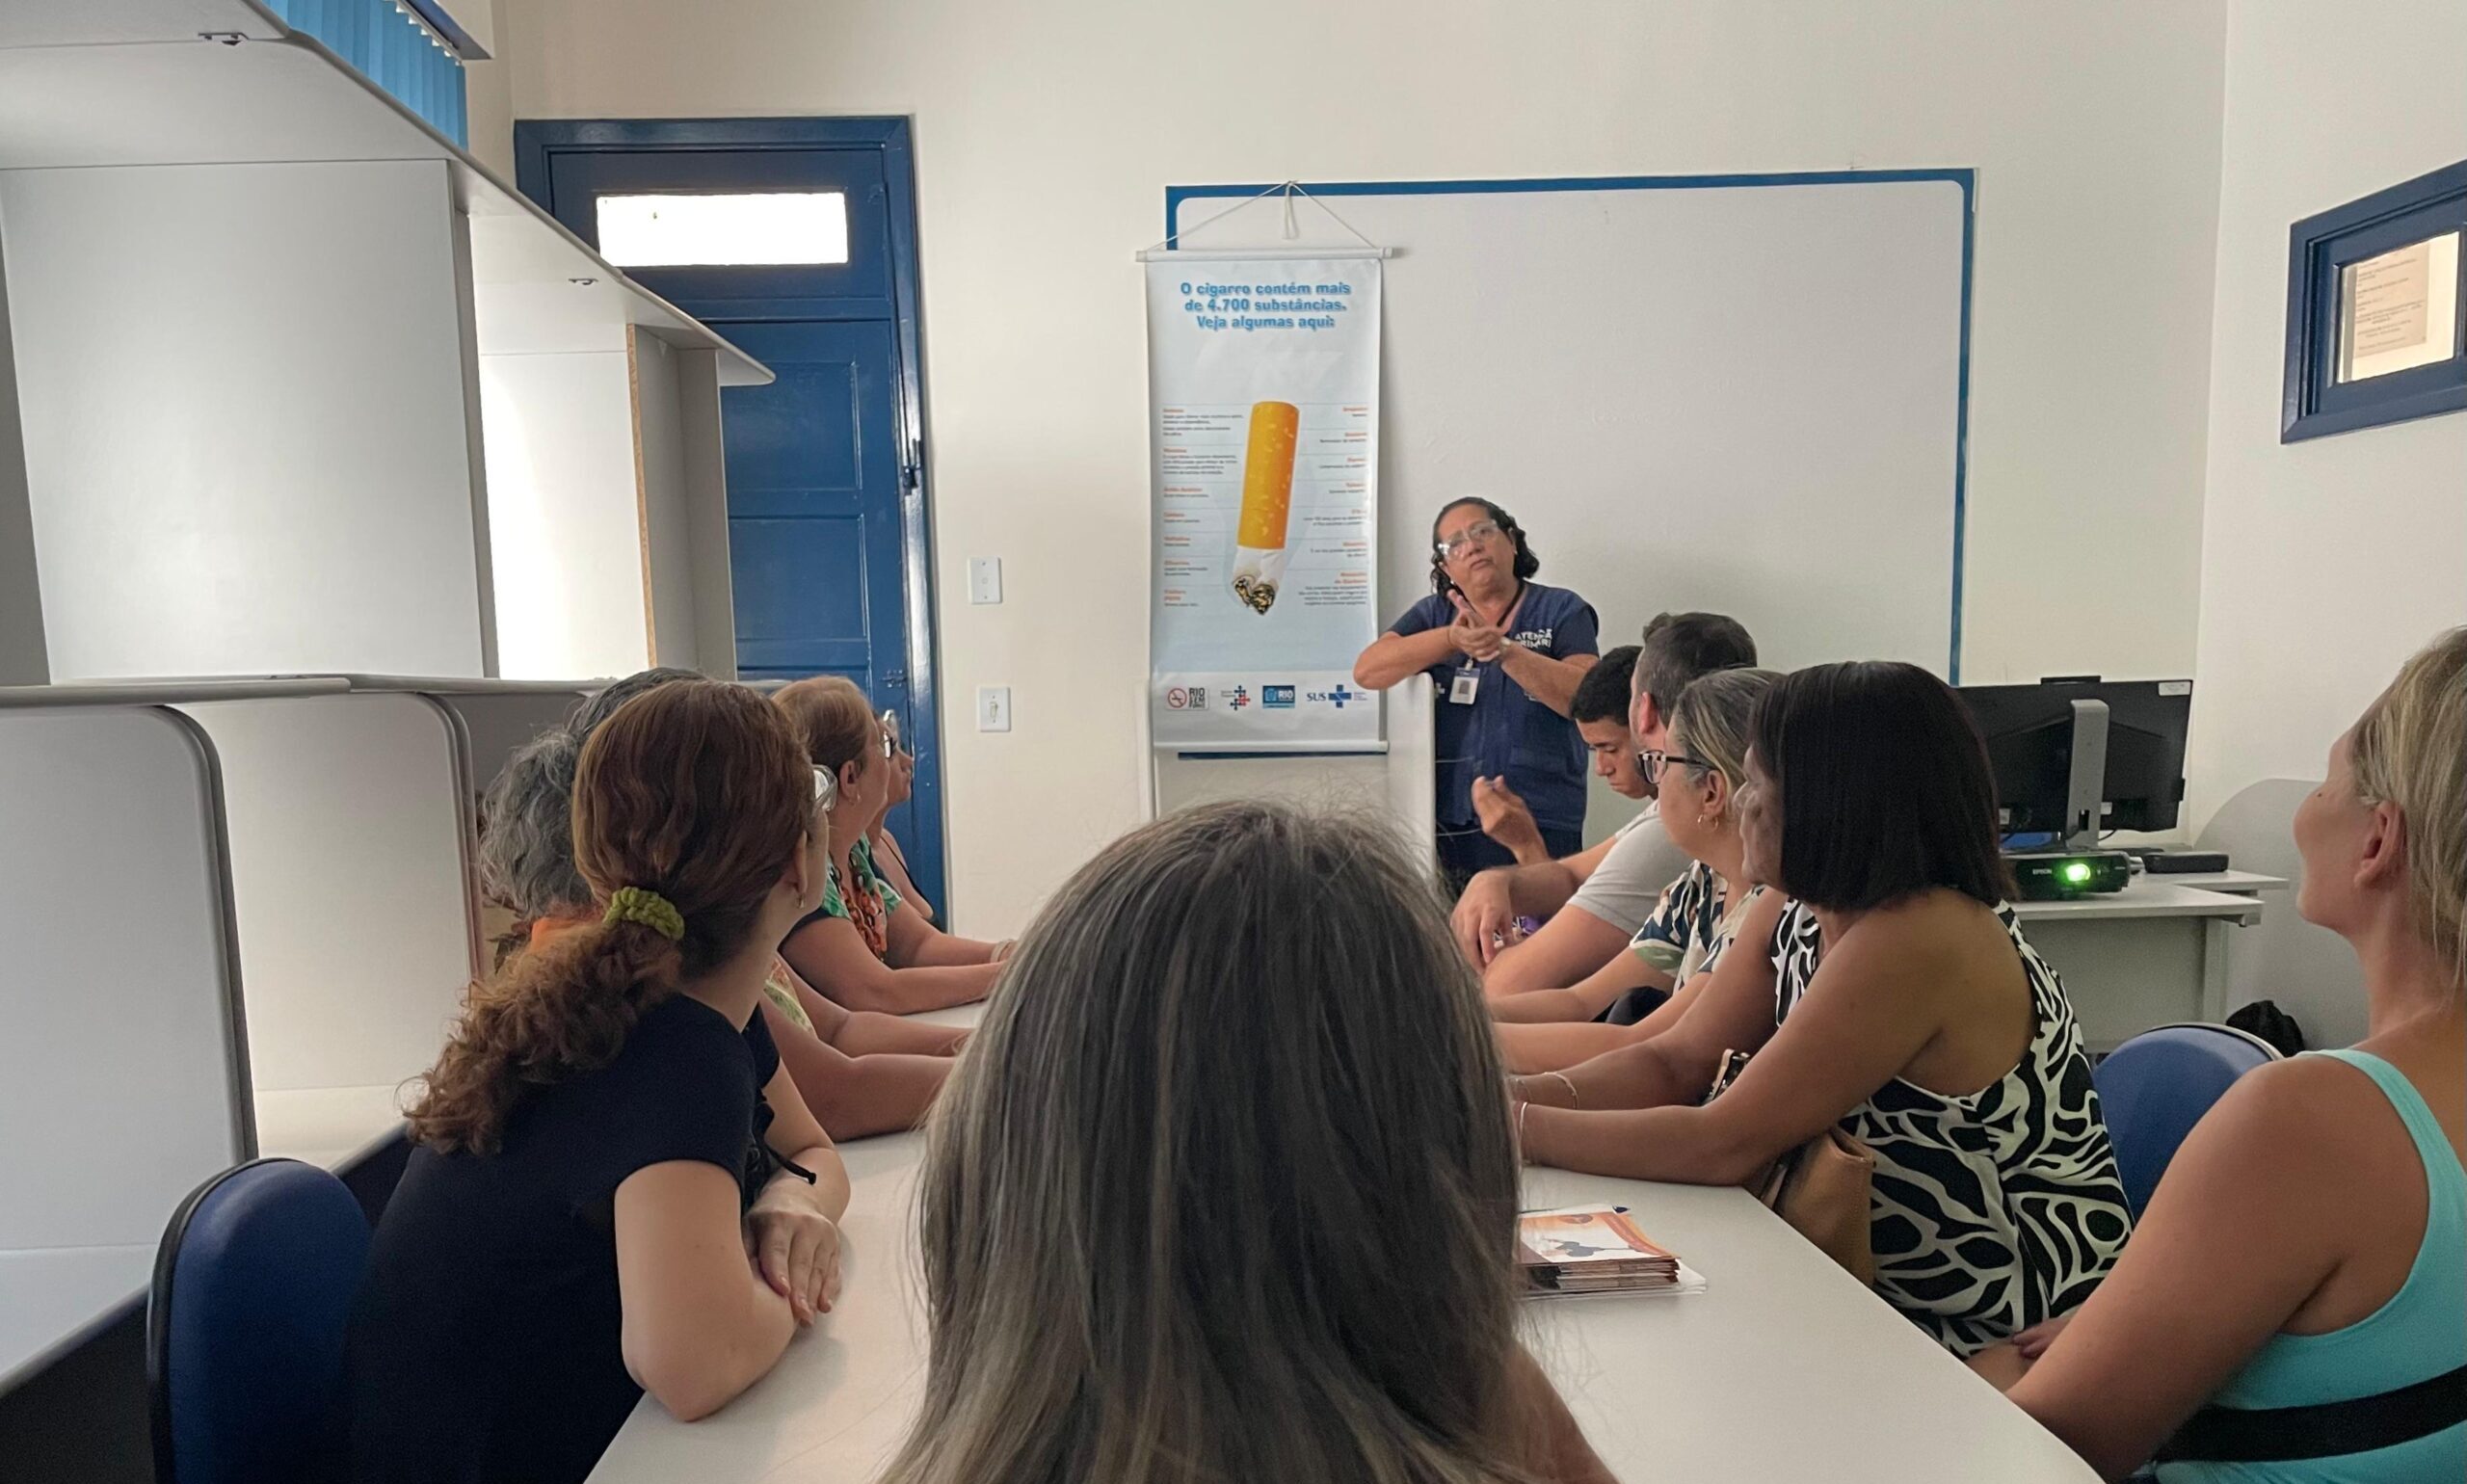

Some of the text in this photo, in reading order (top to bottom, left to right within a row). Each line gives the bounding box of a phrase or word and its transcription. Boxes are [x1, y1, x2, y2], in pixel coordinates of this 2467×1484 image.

[1180, 282, 1351, 297] O cigarro contém mais
[1185, 299, 1347, 311] de 4.700 substâncias.
[1198, 316, 1335, 331] Veja algumas aqui:
[1189, 688, 1205, 697] RIO
[1307, 693, 1326, 702] SUS
